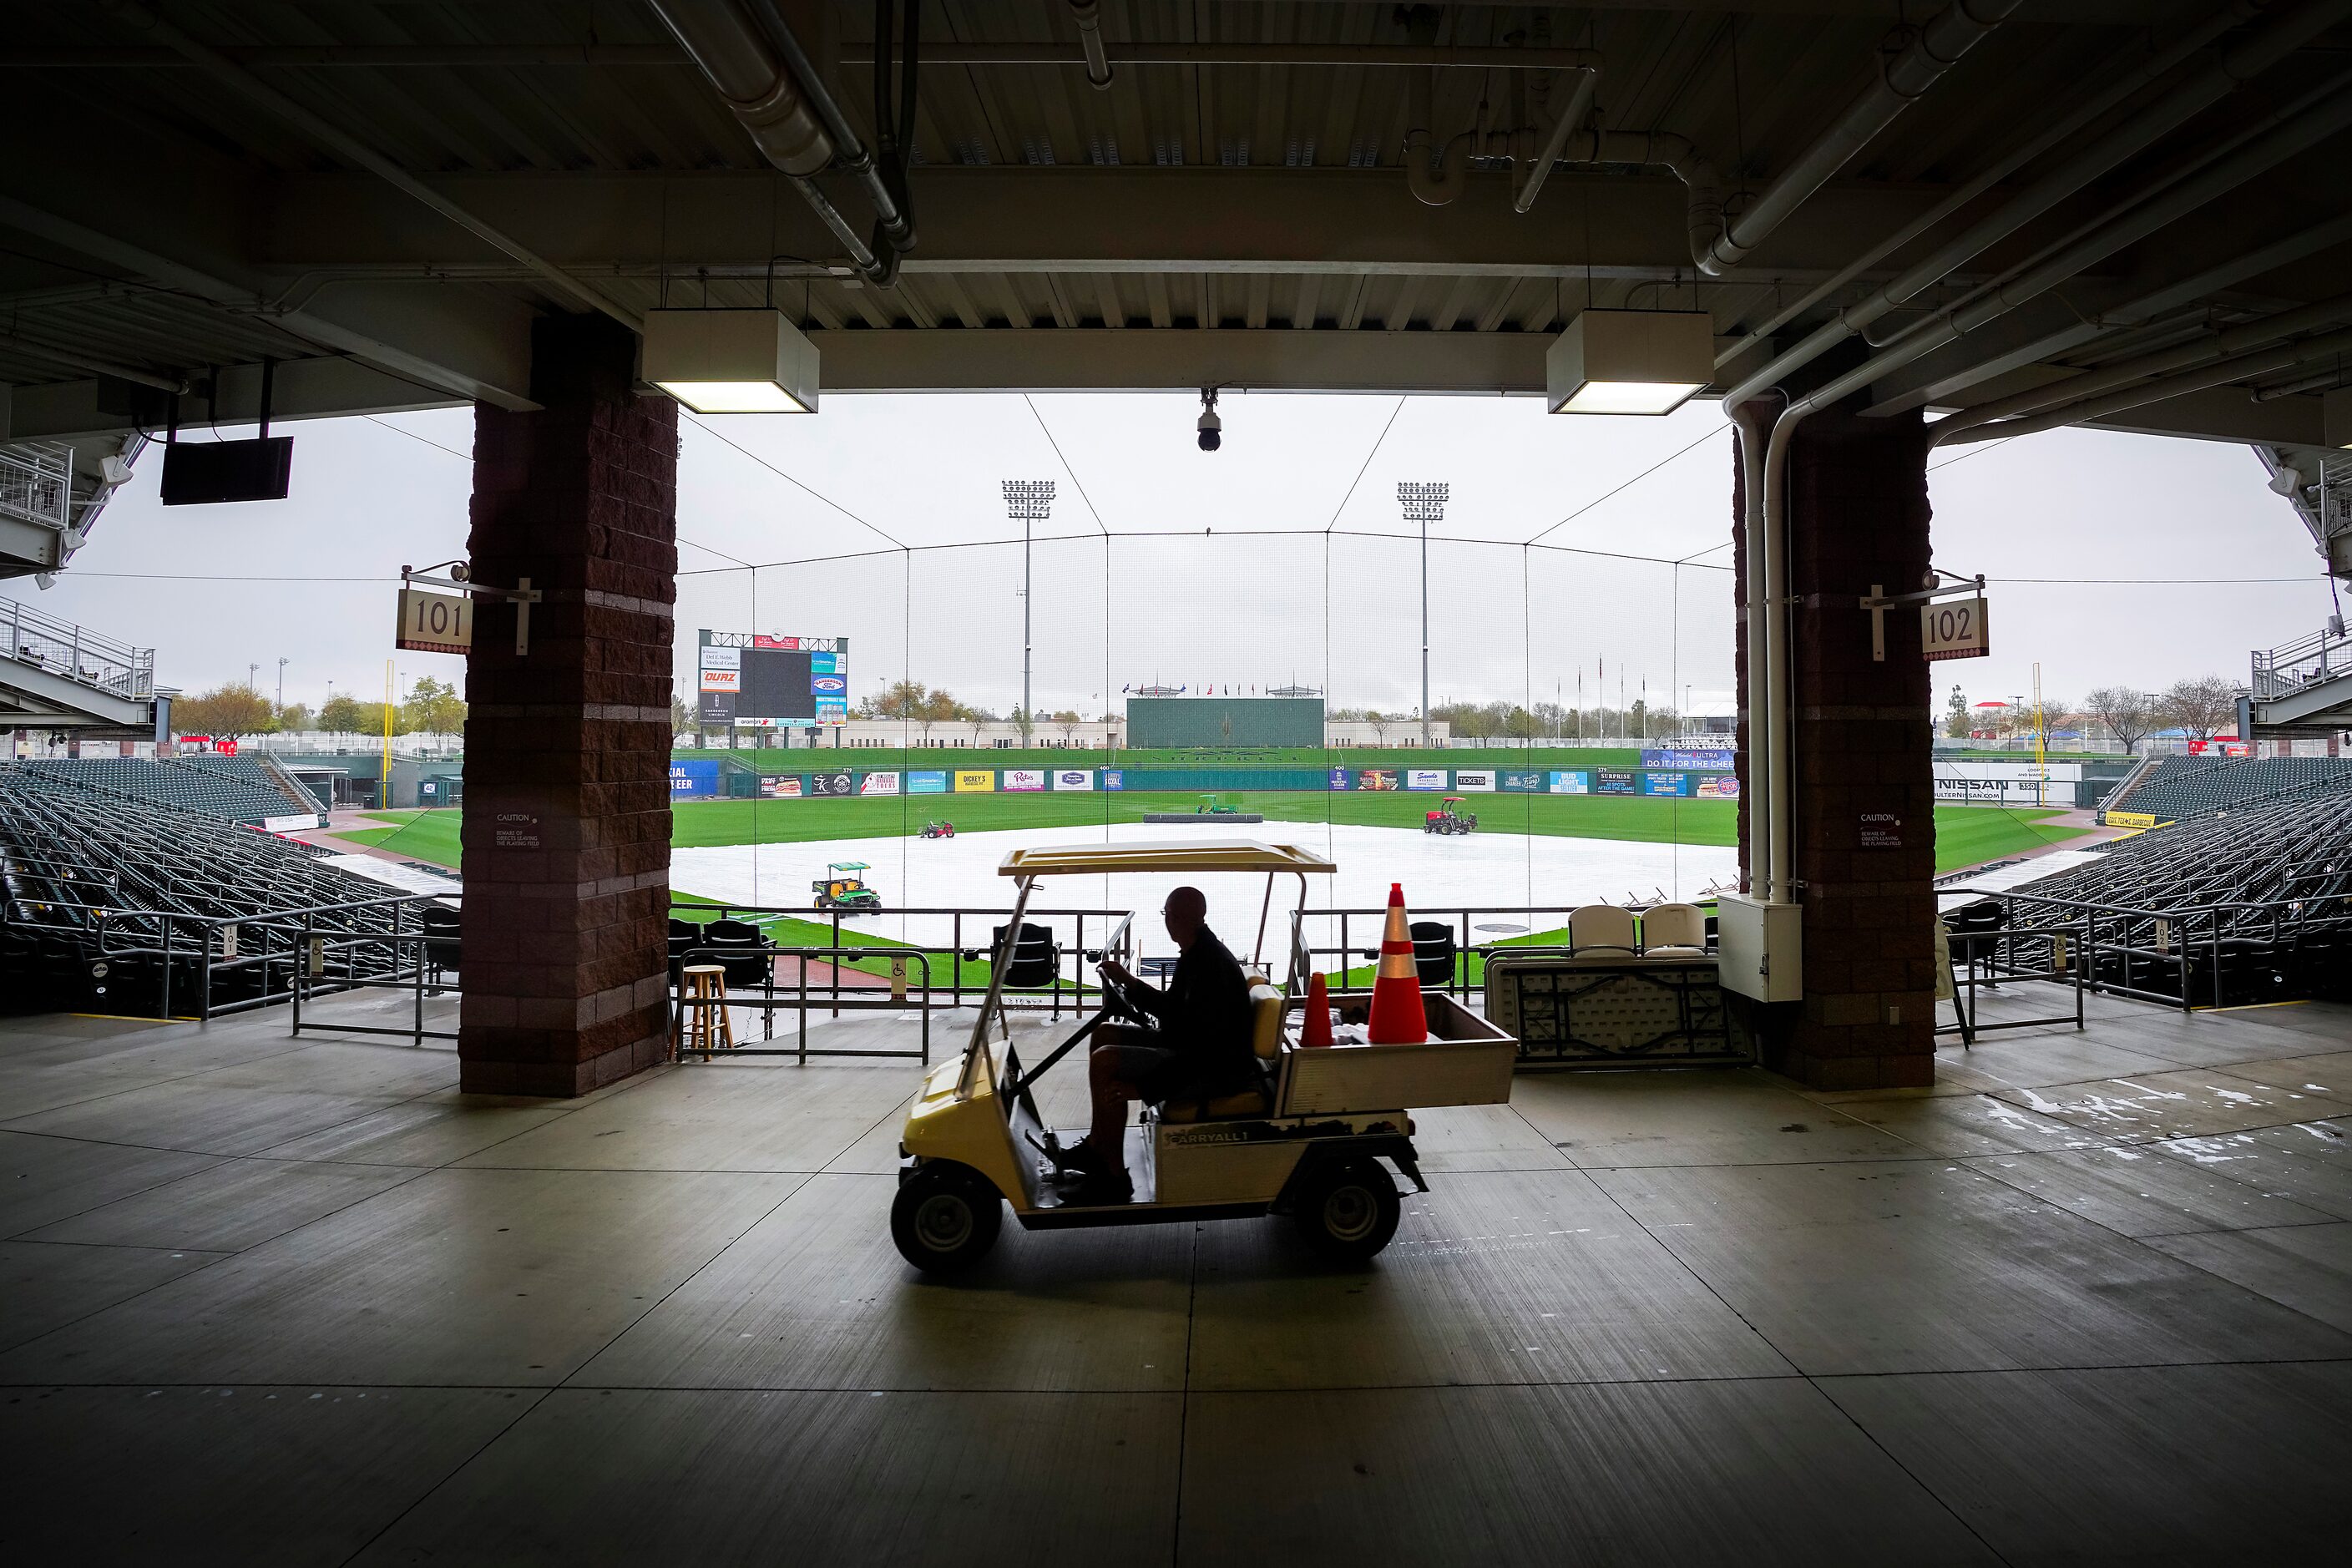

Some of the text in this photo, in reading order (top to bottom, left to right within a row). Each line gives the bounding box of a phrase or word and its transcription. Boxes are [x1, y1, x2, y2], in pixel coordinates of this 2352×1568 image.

[417, 599, 461, 637] 101
[1929, 607, 1973, 644] 102
[1939, 780, 2009, 790] NISSAN
[1169, 1132, 1242, 1145] CARRYALL
